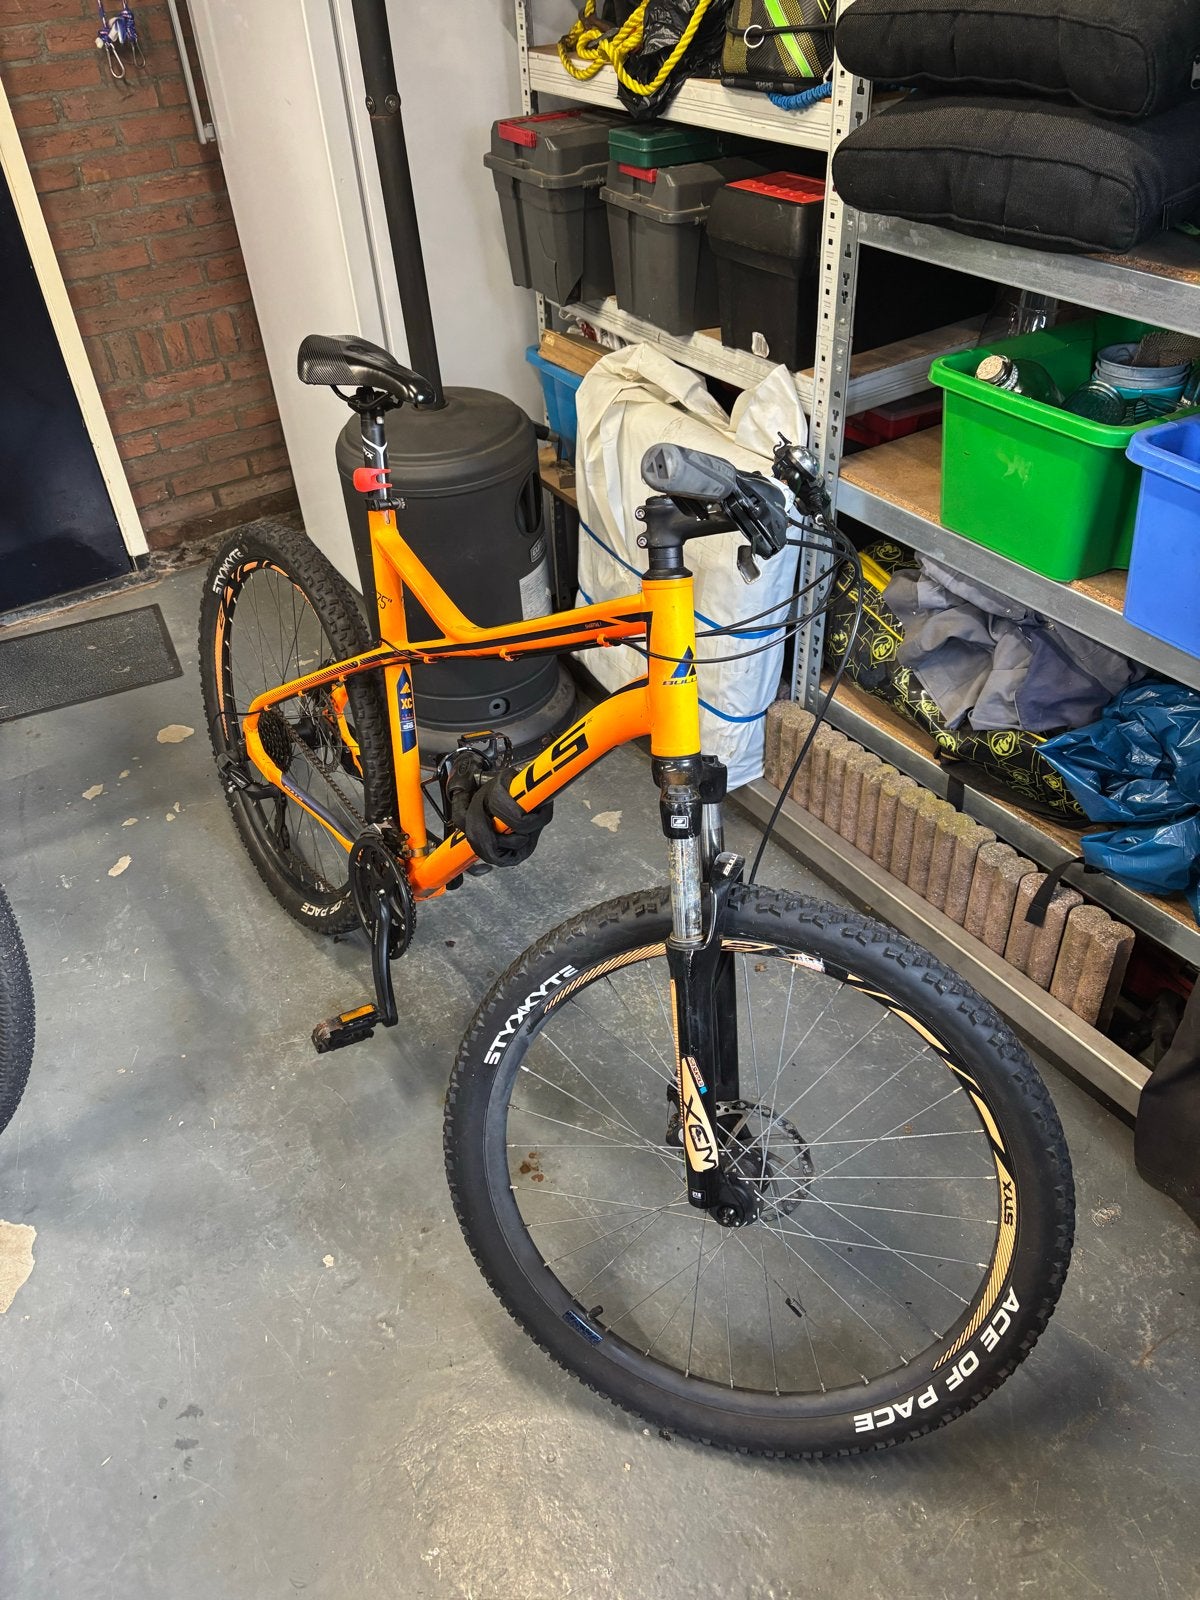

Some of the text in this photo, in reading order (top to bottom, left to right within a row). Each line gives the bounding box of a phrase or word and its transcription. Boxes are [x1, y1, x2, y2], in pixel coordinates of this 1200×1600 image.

[401, 698, 413, 710] XC
[301, 901, 329, 917] PACE
[483, 964, 579, 1065] STYXKYTE
[684, 1096, 718, 1172] XCM
[1002, 1181, 1014, 1226] STYX
[853, 1286, 1020, 1433] ACE OF PACE
